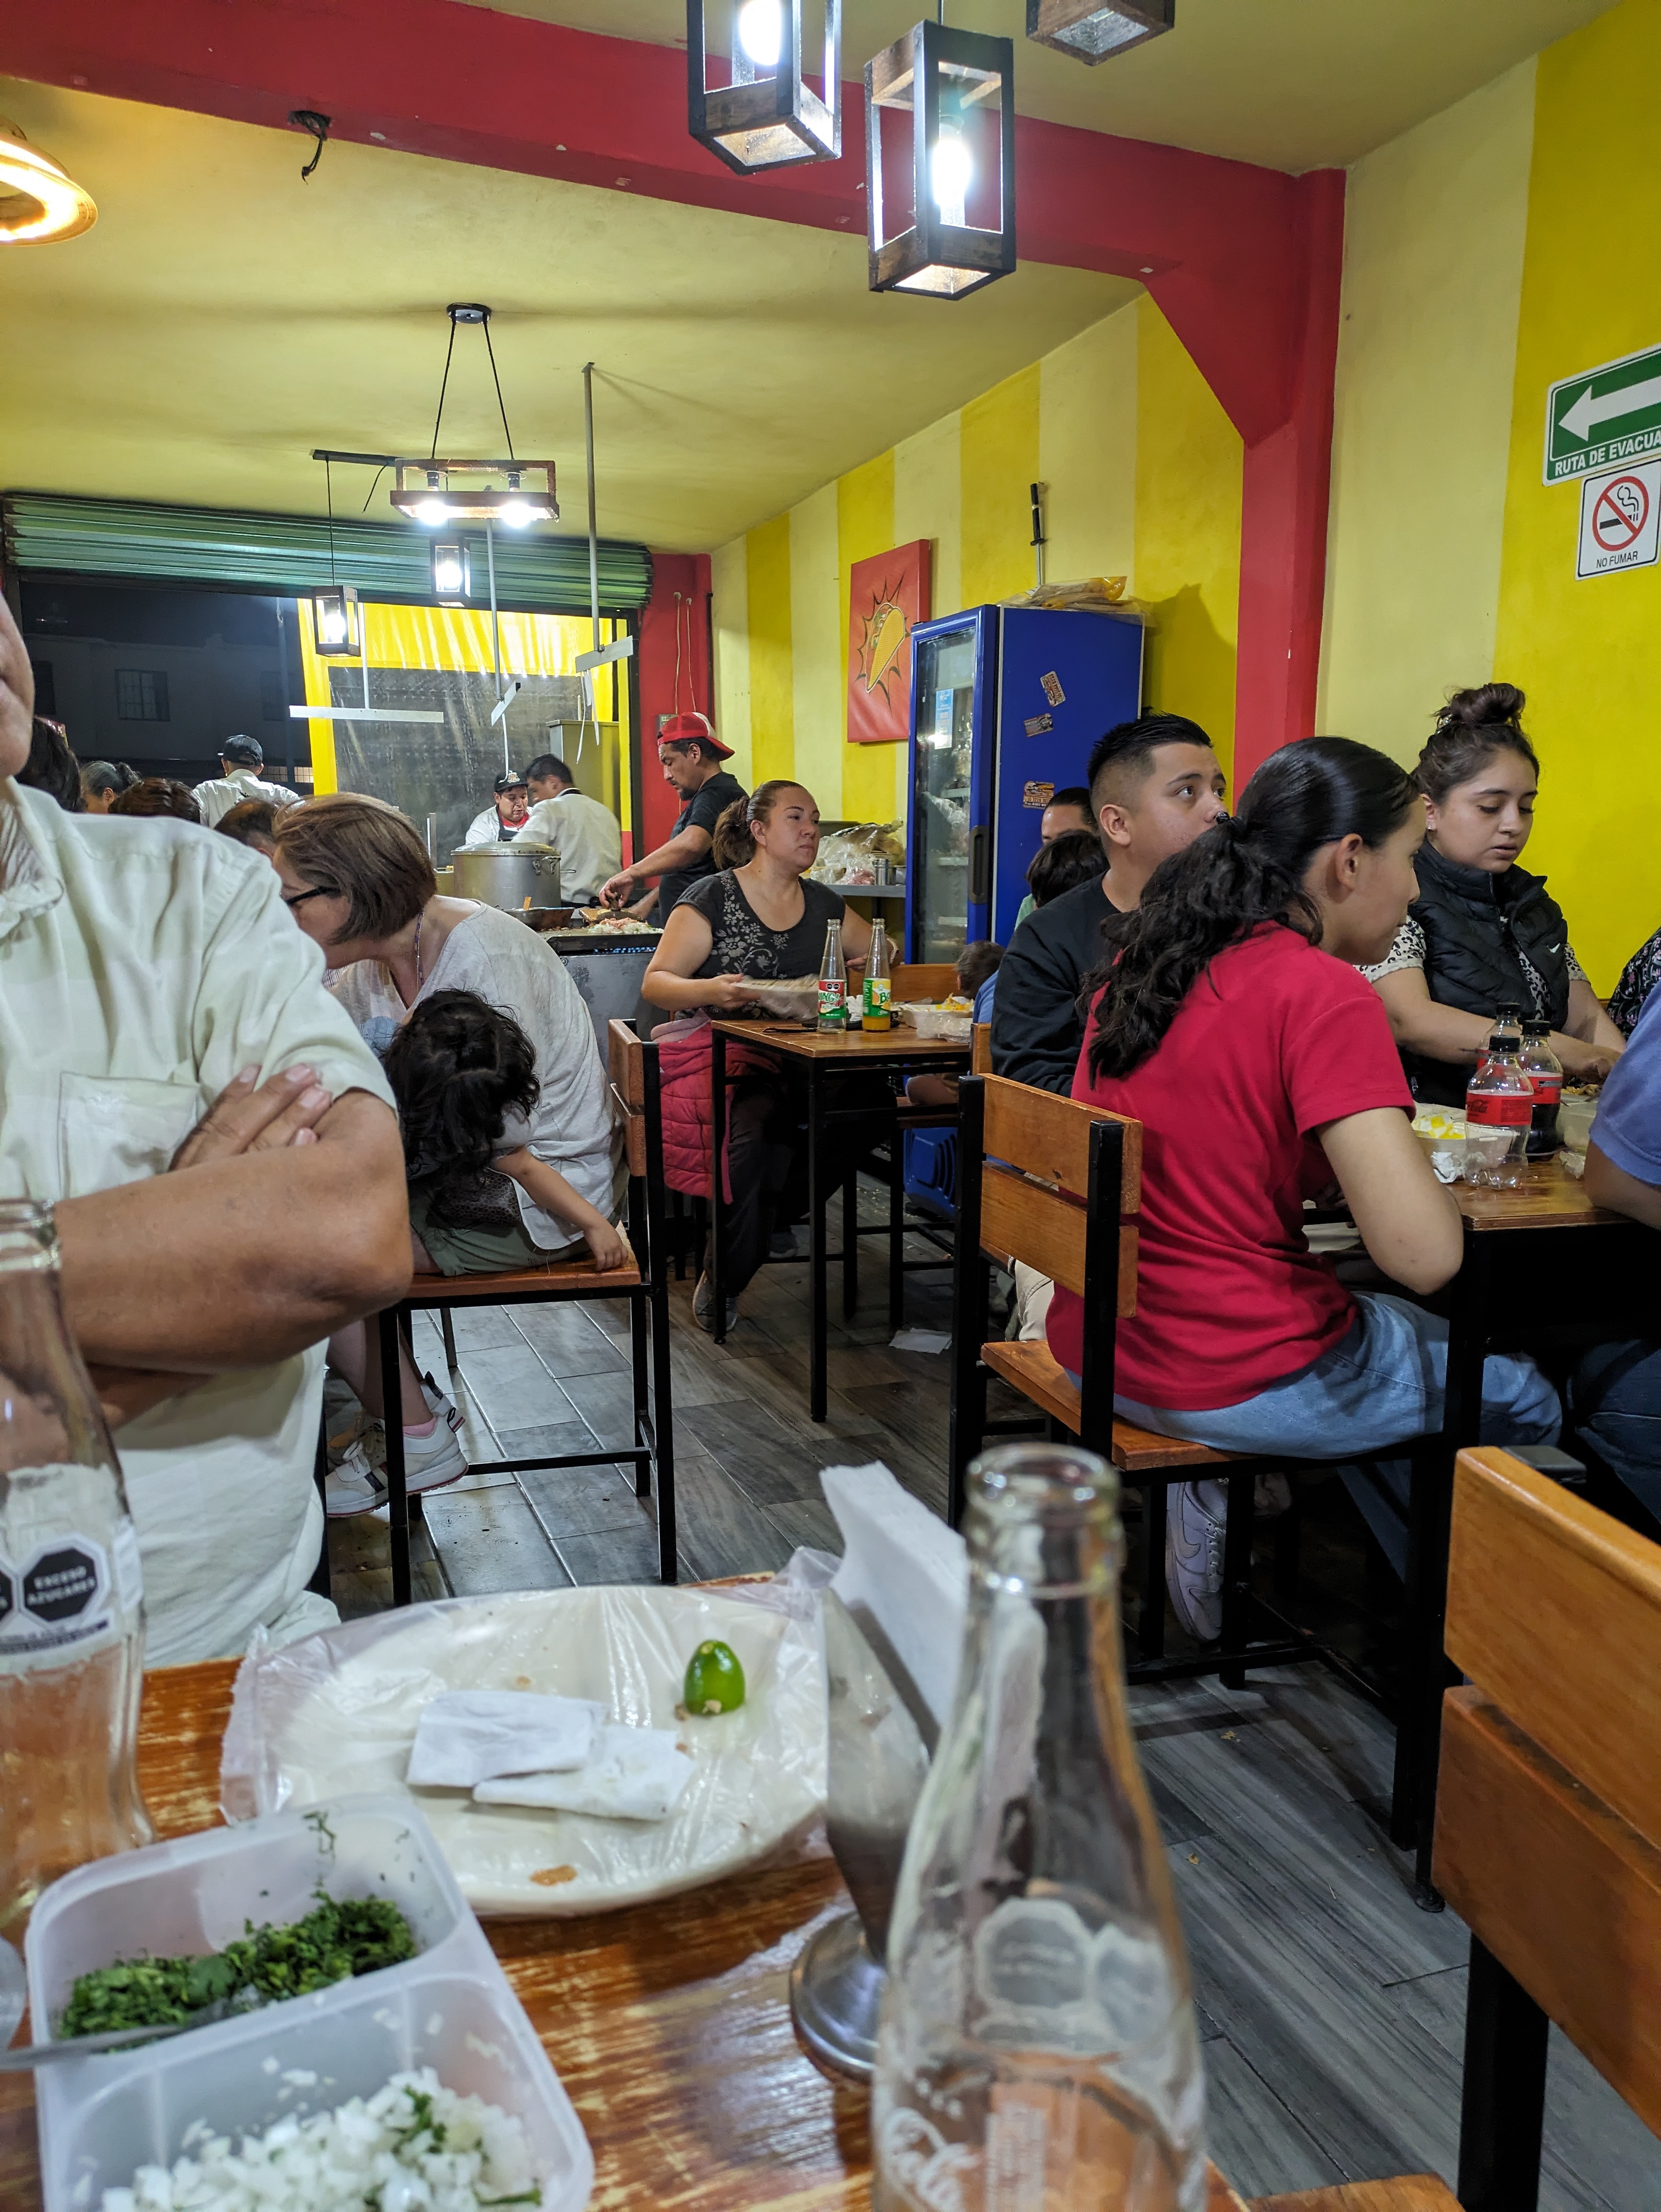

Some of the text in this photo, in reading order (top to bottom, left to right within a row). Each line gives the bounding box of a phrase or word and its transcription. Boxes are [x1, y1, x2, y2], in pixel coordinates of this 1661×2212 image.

[1555, 454, 1586, 476] RUTA
[1589, 447, 1606, 466] DE
[1596, 551, 1638, 568] NO FUMAR
